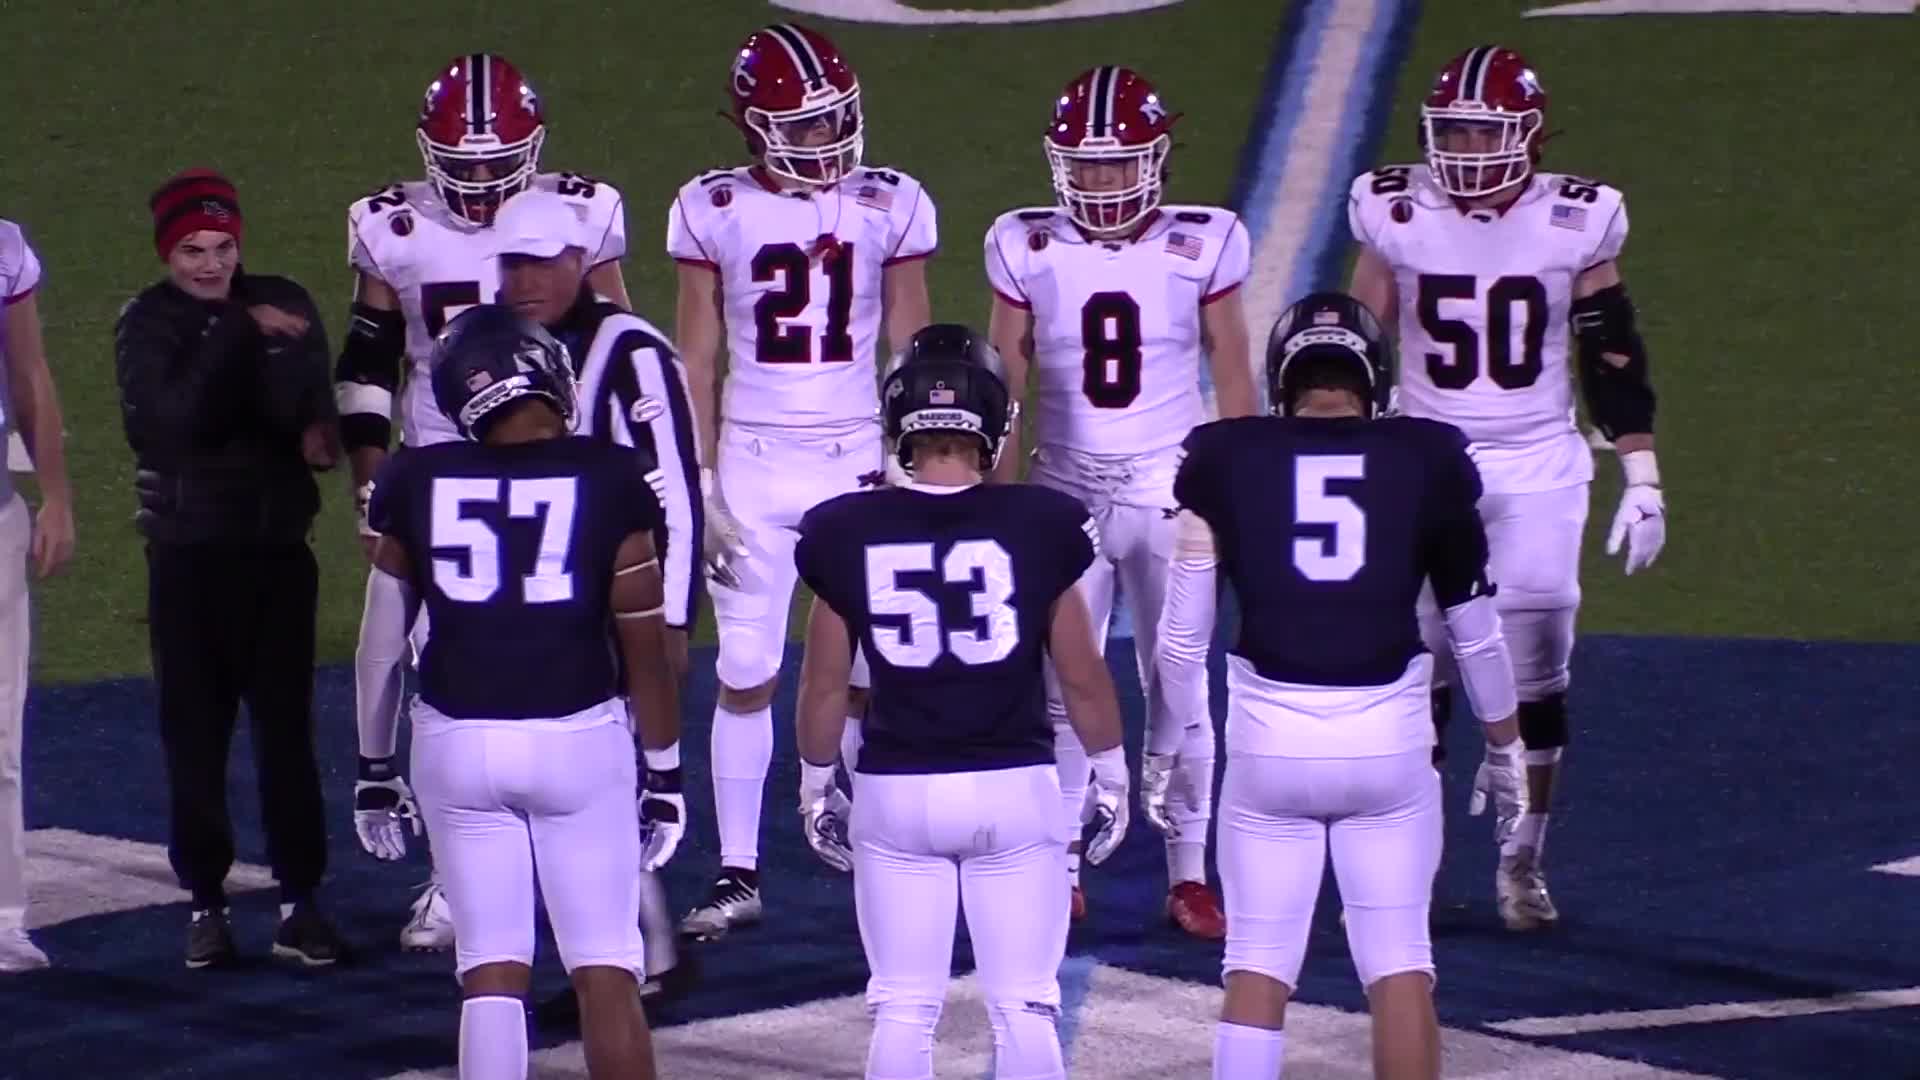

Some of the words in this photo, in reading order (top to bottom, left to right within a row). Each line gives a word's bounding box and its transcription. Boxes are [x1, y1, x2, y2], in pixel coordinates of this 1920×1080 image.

[751, 243, 855, 363] 21
[1081, 290, 1142, 409] 8
[1417, 273, 1549, 390] 50
[431, 476, 578, 603] 57
[1293, 454, 1367, 581] 5
[864, 538, 1020, 668] 53
